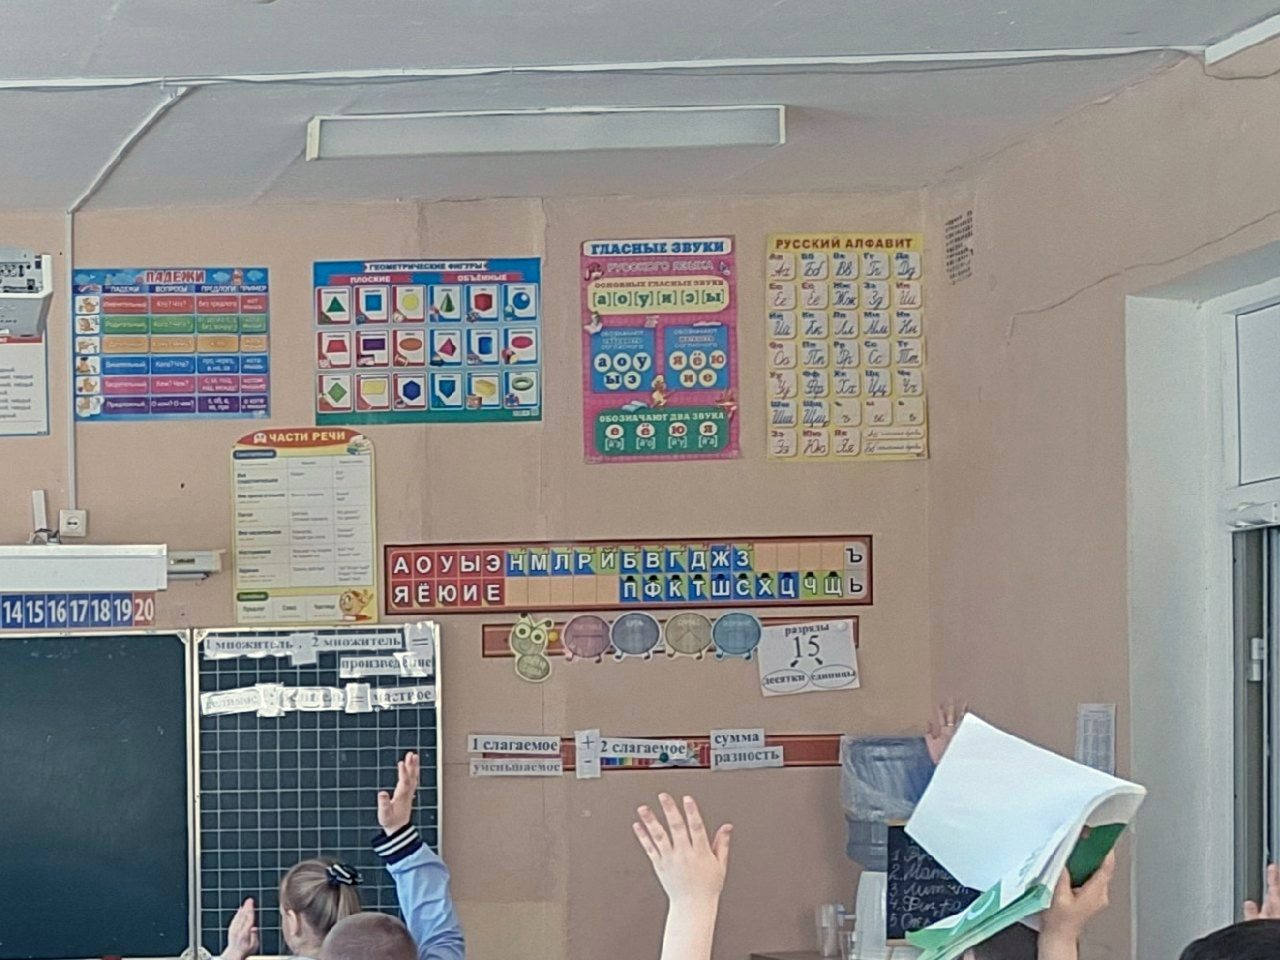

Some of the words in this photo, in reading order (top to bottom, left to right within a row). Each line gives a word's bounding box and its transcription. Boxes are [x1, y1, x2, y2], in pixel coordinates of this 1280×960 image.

[591, 243, 667, 255] ГЛАСНЫЕ
[671, 241, 724, 253] ЗВУКИ
[776, 238, 840, 249] РУССКИЙ
[845, 239, 913, 249] АЛФАВИТ
[370, 263, 446, 271] ГЕОМЕТРИЧЕСКИЕ
[146, 271, 205, 283] ПАДЕЖИ
[350, 275, 391, 284] ПЛОСКИЕ
[457, 273, 508, 282] ОБЪЁМНЫЕ
[155, 285, 188, 293] ВОПРОСЫ
[201, 285, 237, 293] ПРЕДЛОГИ
[594, 281, 646, 289] ОСНОВНЫЕ
[600, 414, 667, 423] ОБОЗНАЧАЮТ
[669, 413, 690, 421] ДВА
[692, 412, 724, 421] ЗВУКА
[269, 432, 308, 443] ЧАСТИ
[312, 431, 345, 442] РЕЧИ
[394, 556, 409, 573] А
[417, 556, 431, 573] О
[440, 556, 453, 572] У
[461, 556, 480, 572] Ы
[486, 555, 501, 572] Э
[510, 553, 523, 571] Н
[531, 553, 547, 570] М
[554, 553, 569, 570] Л
[578, 553, 591, 570] Р
[601, 548, 614, 569] Й
[623, 552, 637, 569] Б
[646, 552, 660, 569] В
[670, 551, 683, 568] Г
[691, 551, 706, 571] Д
[711, 551, 729, 567] Ж
[736, 550, 750, 567] З
[846, 548, 863, 563] Ъ
[394, 586, 409, 603] Я
[418, 582, 430, 602] Ё
[438, 585, 457, 602] Ю
[463, 585, 477, 602] И
[487, 585, 500, 601] Е
[624, 582, 636, 598] П
[644, 580, 661, 598] Ф
[670, 580, 682, 597] К
[693, 580, 705, 596] Т
[712, 580, 730, 596] Ш
[736, 579, 750, 596] С
[758, 579, 773, 596] Х
[781, 579, 795, 597] Ц
[804, 578, 817, 594] Ч
[824, 578, 843, 597] Щ
[850, 578, 863, 593] Ь
[3, 601, 22, 624] 14
[26, 600, 44, 623] 15
[48, 600, 66, 622] 16
[70, 599, 88, 622] 17
[91, 599, 111, 622] 18
[114, 599, 132, 621] 19
[134, 598, 155, 621] 20
[785, 624, 829, 637] разряды
[205, 638, 212, 649] 1
[215, 638, 294, 650] множитель
[312, 637, 319, 647] 2
[324, 635, 401, 648] множитель
[794, 635, 820, 658] 15
[765, 675, 805, 685] десятки
[714, 731, 760, 745] сумма
[472, 738, 479, 751] 1
[483, 738, 558, 752] слагаемое
[600, 740, 609, 753] 2
[612, 741, 686, 756] слагаемое
[714, 749, 781, 766] разность
[472, 760, 561, 775] уменьшаемое
